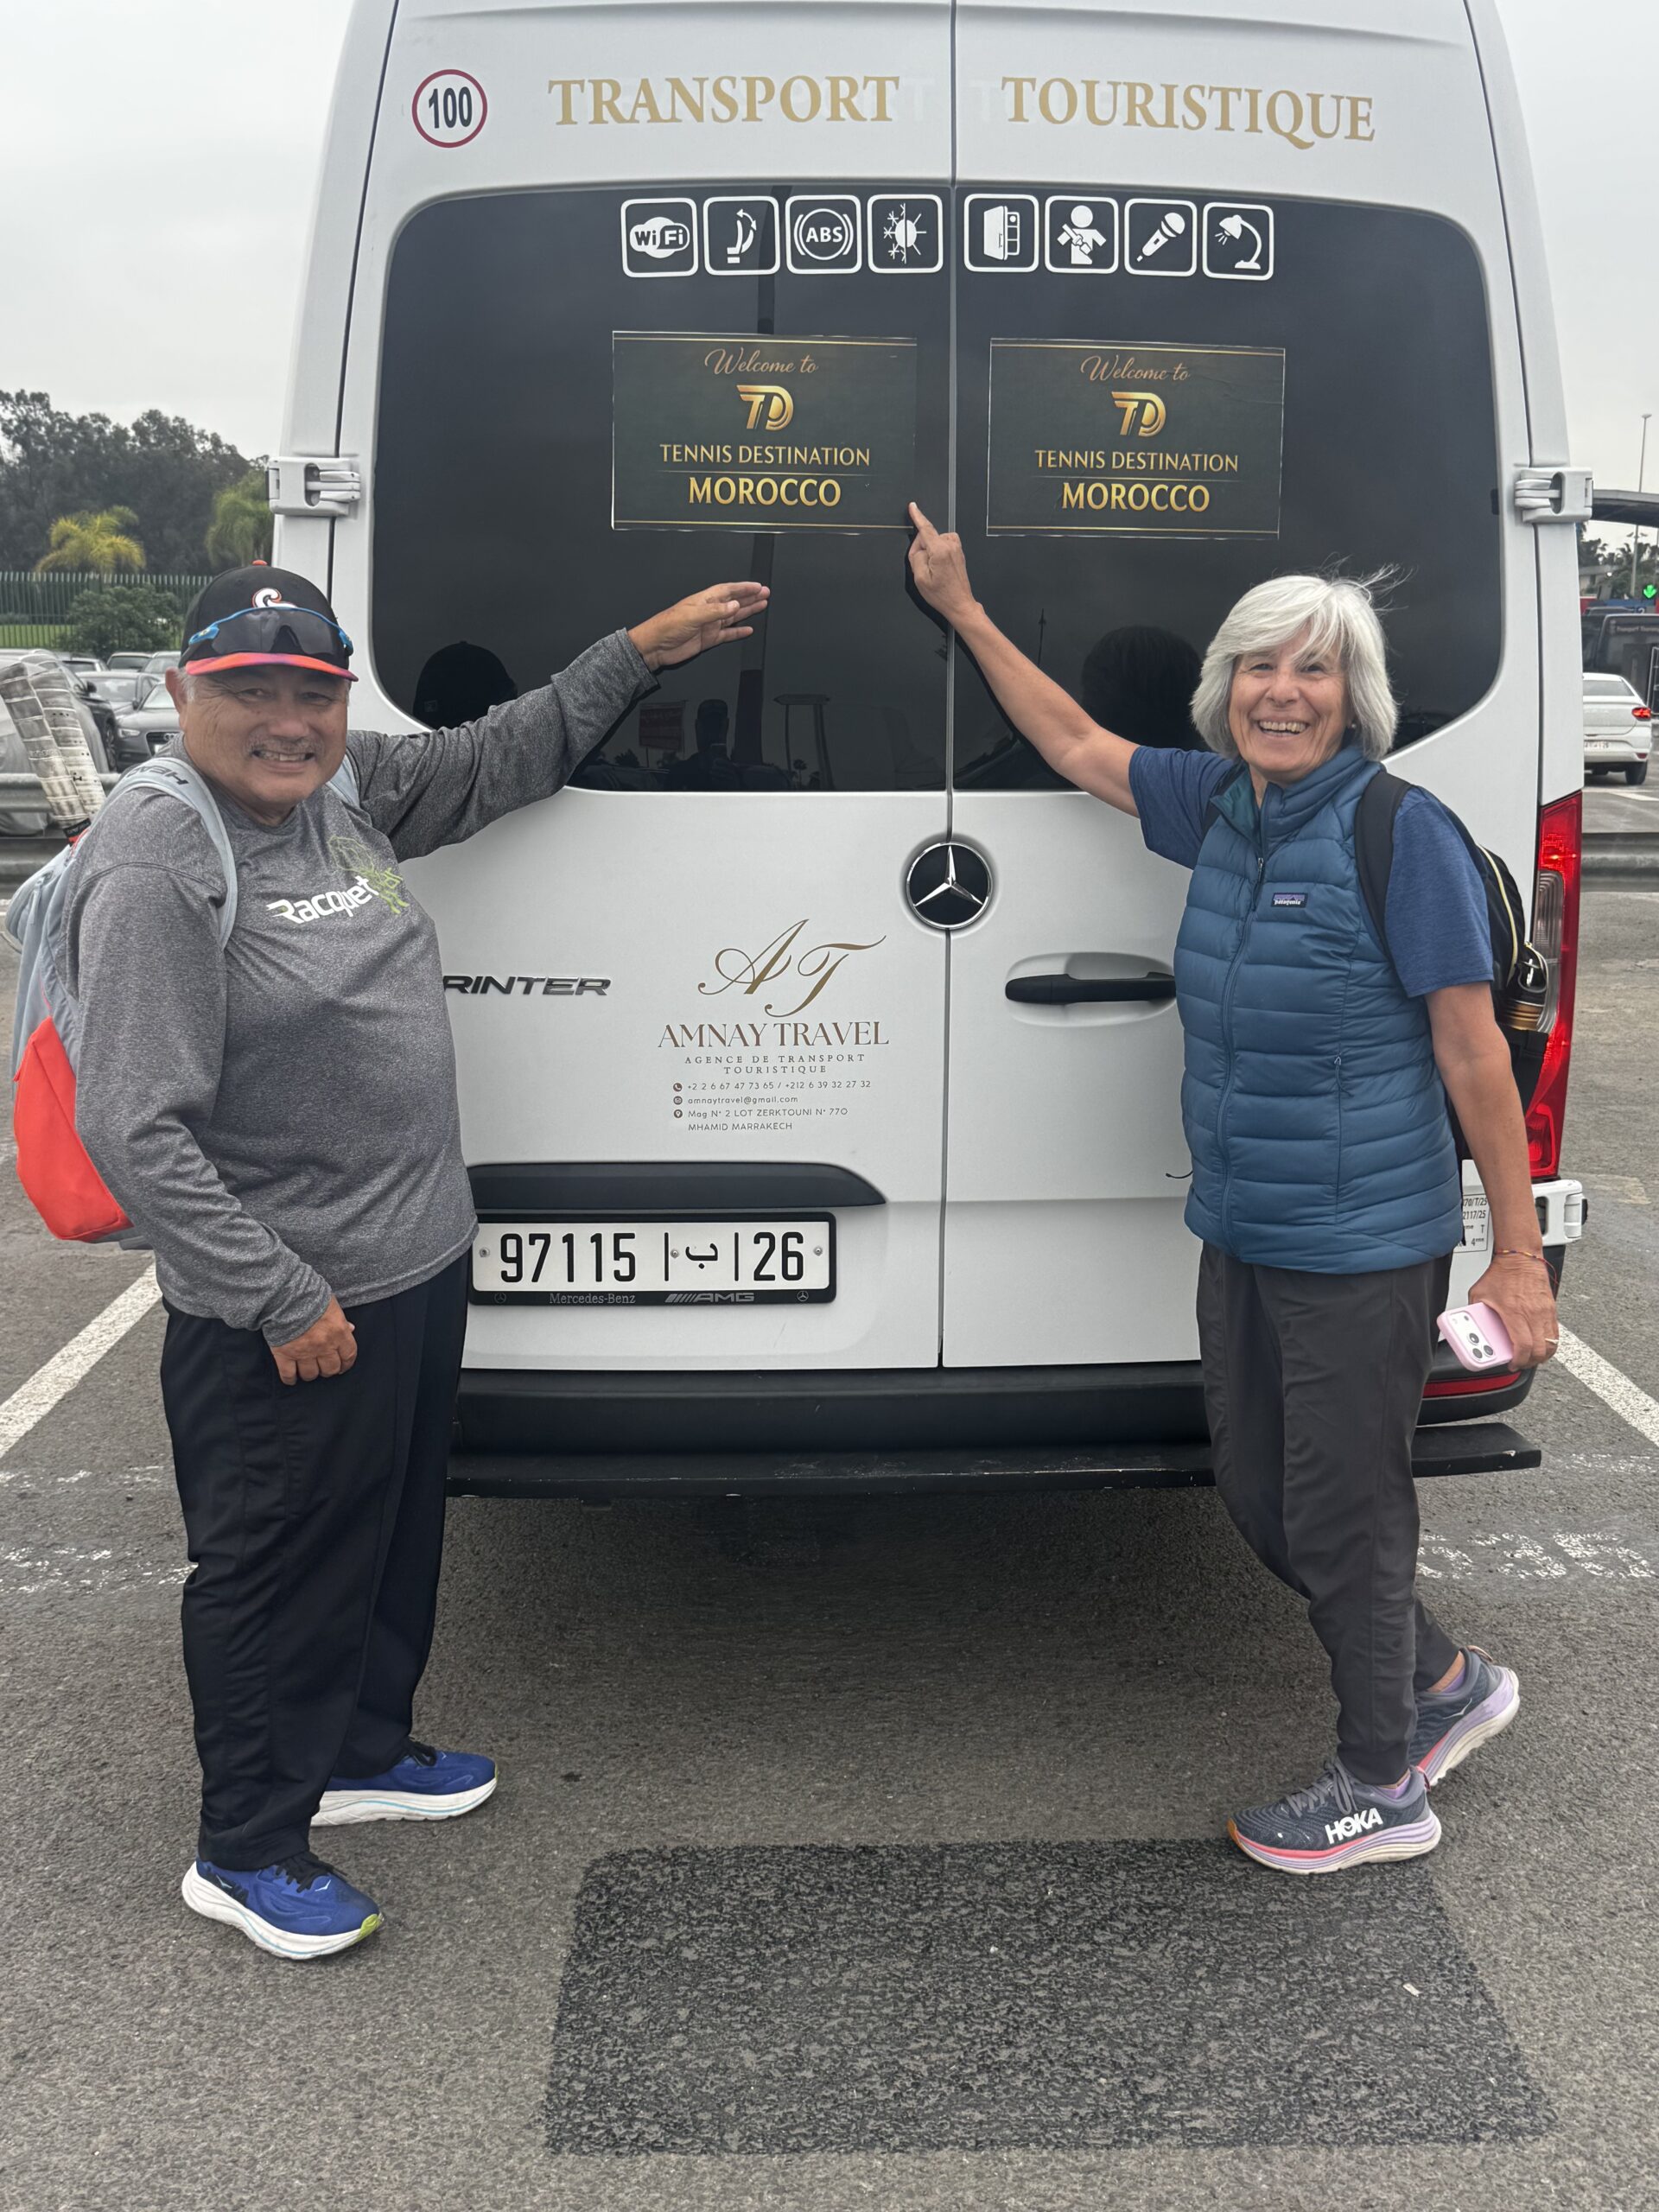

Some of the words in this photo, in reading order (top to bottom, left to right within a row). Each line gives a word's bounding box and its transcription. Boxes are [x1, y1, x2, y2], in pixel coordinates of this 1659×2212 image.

[428, 86, 473, 129] 100
[548, 75, 900, 125] TRANSPORT
[1001, 76, 1376, 150] TOURISTIQUE
[634, 229, 683, 246] WiFi
[805, 226, 843, 243] ABS
[704, 347, 795, 375] Welcome
[797, 356, 819, 374] to
[1080, 354, 1167, 381] Welcome
[1172, 362, 1192, 381] to
[659, 443, 732, 464] TENNIS
[738, 445, 871, 467] DESTINATION
[1034, 449, 1106, 469] TENNIS
[1111, 450, 1238, 473] DESTINATION
[689, 476, 842, 507] MOROCCO
[1061, 482, 1211, 512] MOROCCO
[266, 875, 379, 925] Racquet
[442, 976, 612, 995] RINTER
[658, 1023, 767, 1048] AMNAY
[773, 1021, 890, 1046] TRAVEL
[724, 1065, 826, 1074] TOURISTIQUE
[779, 1053, 865, 1063] TRANSPORT
[719, 1082, 730, 1090] 67
[785, 1081, 804, 1090] +212
[846, 1080, 856, 1089] 27
[688, 1096, 798, 1105] amnaytravel@gmail.com
[688, 1110, 708, 1119] Mag
[500, 1232, 636, 1283] 97115
[685, 1243, 718, 1269] ب
[753, 1231, 804, 1281] 26
[549, 1293, 636, 1304] Mercedes-Benz
[694, 1292, 755, 1303] AMG
[1324, 1807, 1383, 1845] HOKA
